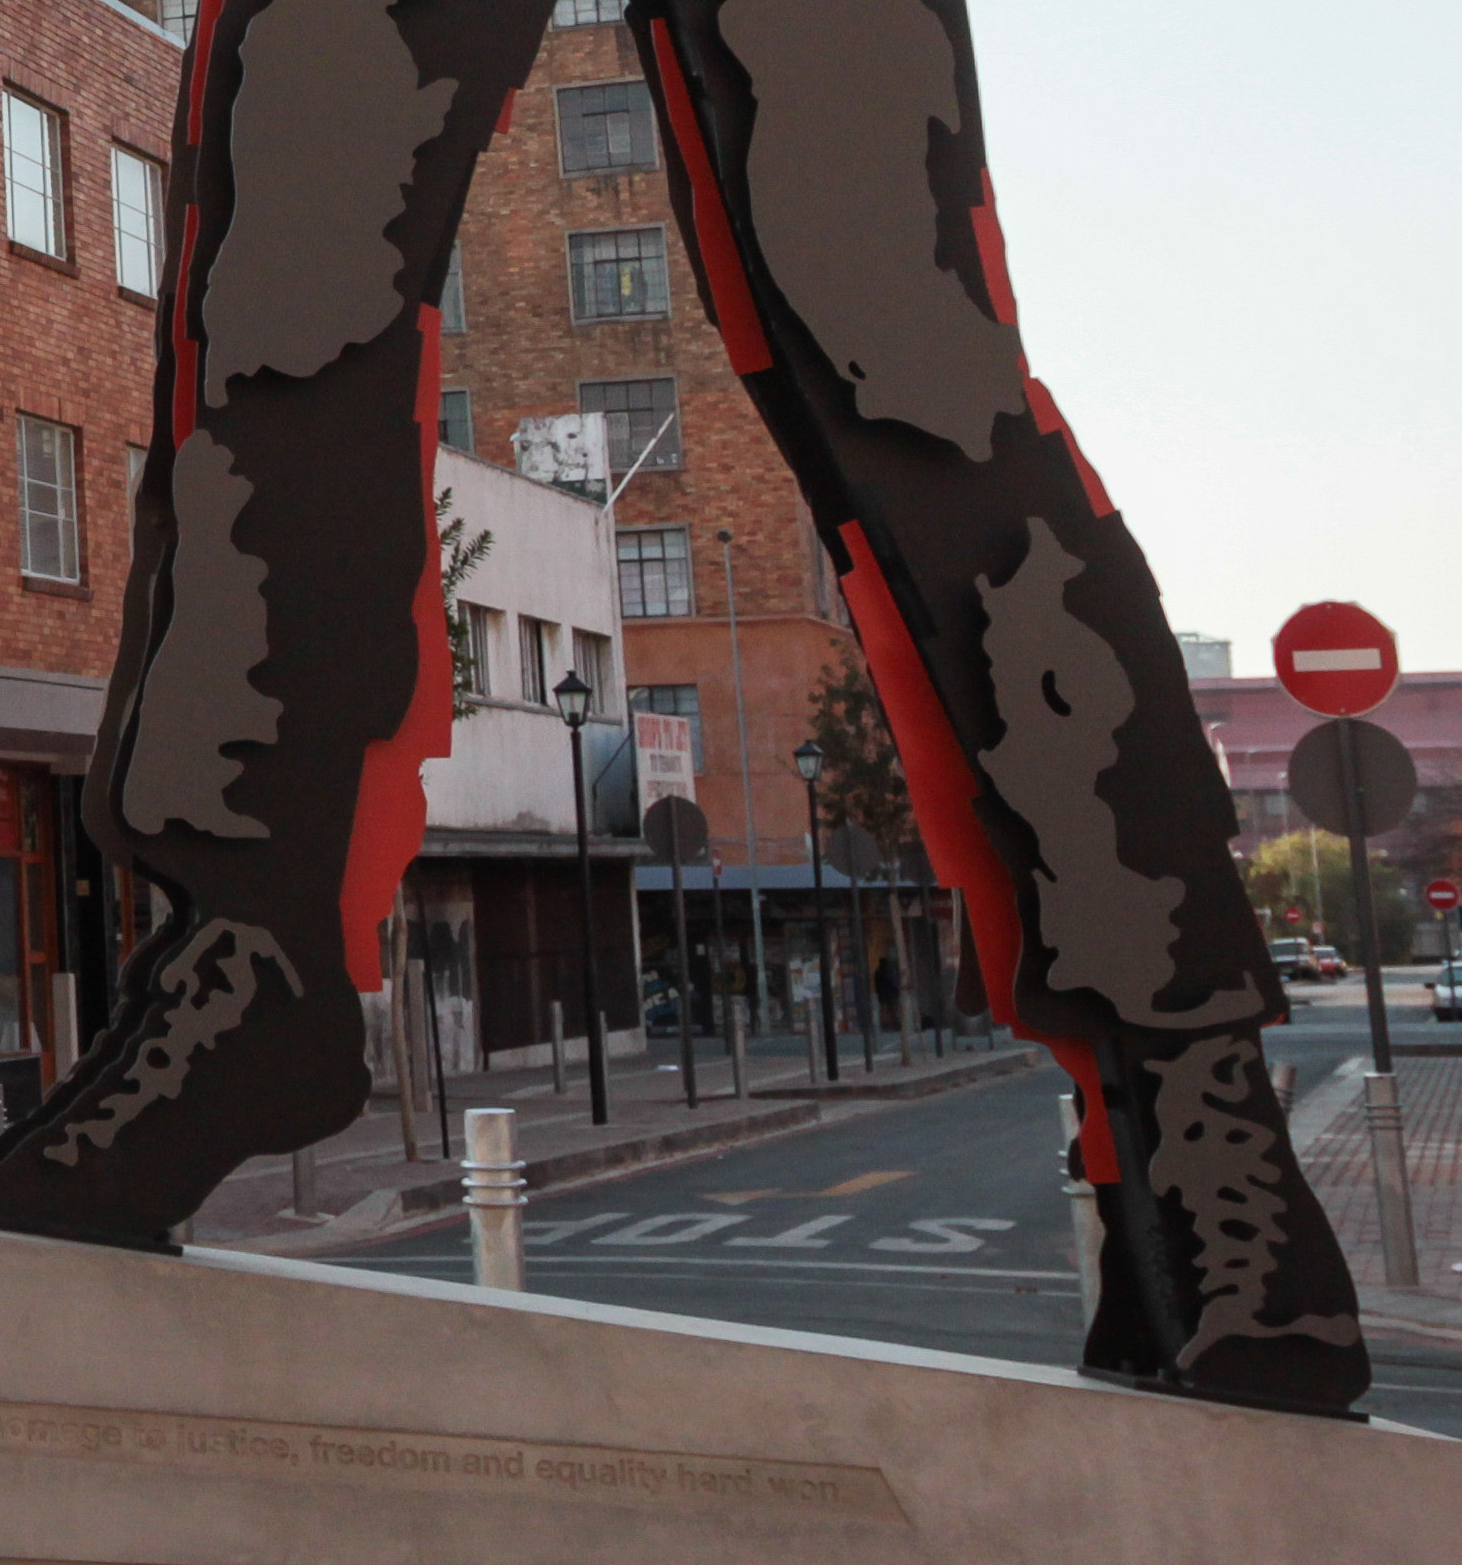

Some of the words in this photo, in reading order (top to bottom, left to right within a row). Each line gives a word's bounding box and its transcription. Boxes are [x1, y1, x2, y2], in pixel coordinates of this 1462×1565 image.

[308, 1434, 451, 1474] freedom
[462, 1450, 525, 1479] and
[534, 1458, 668, 1497] equality
